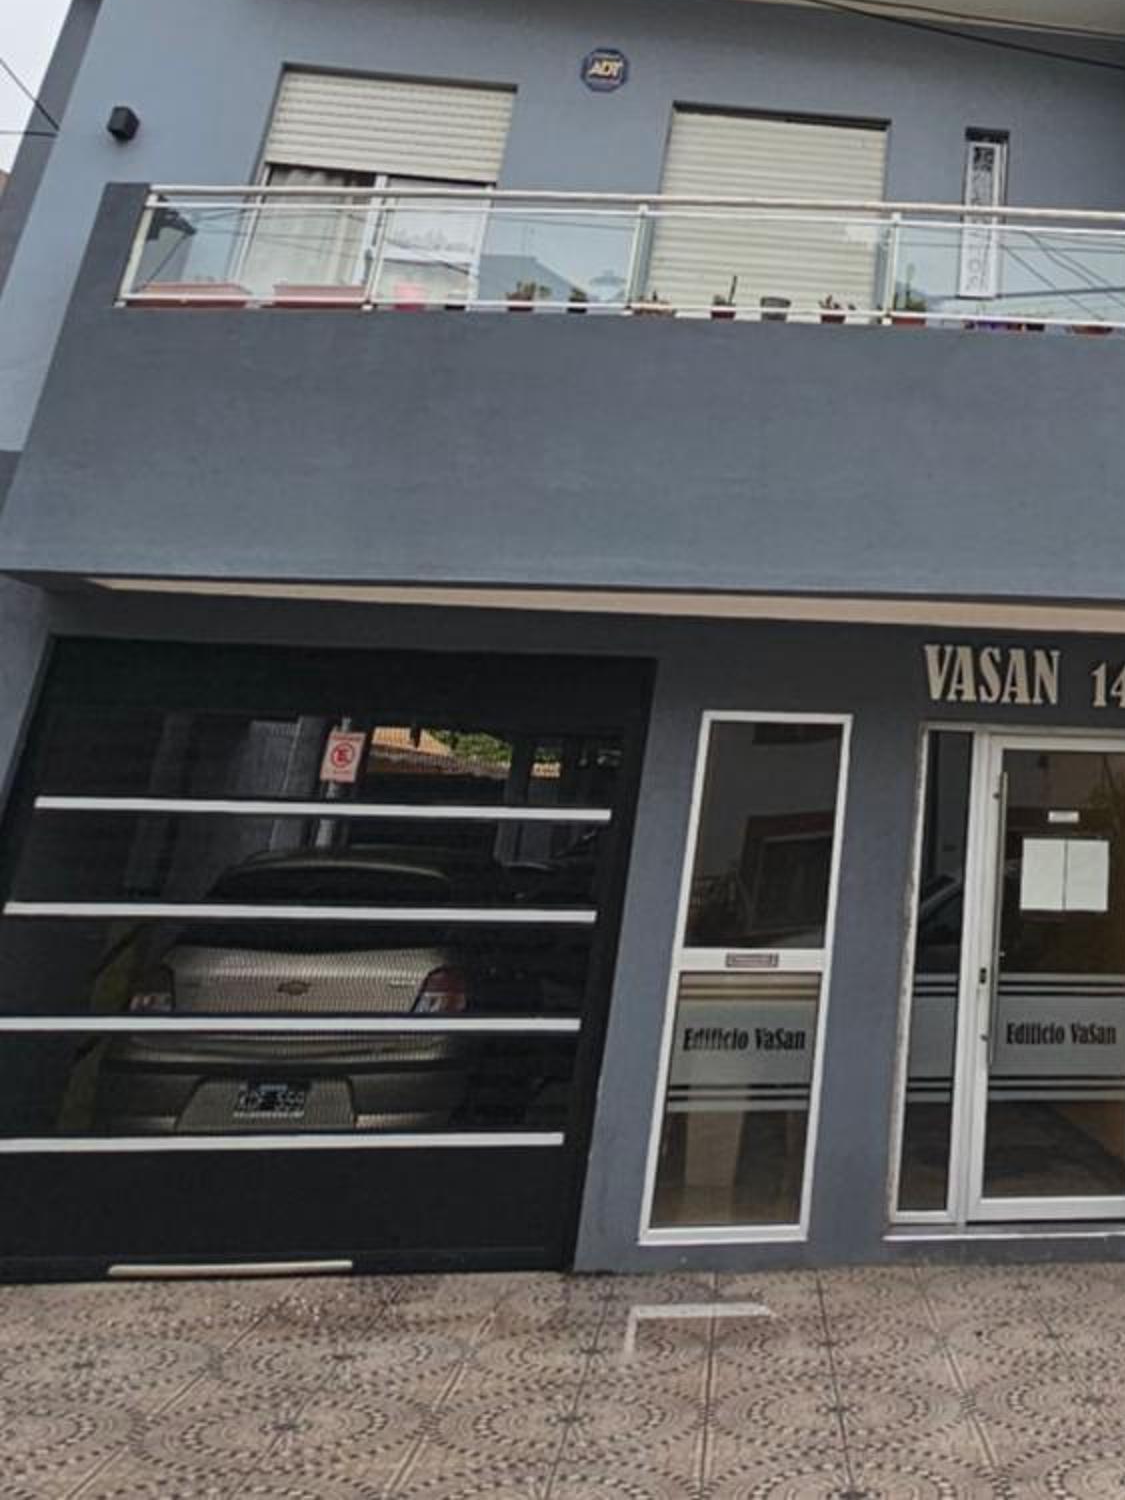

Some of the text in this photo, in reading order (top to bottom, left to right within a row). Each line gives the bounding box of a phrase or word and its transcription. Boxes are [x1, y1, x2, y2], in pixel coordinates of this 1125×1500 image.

[588, 60, 623, 76] ADT
[924, 645, 1060, 704] VASAN
[683, 1027, 806, 1051] Edificio VaSan
[1006, 1022, 1116, 1045] Edificio VaSan
